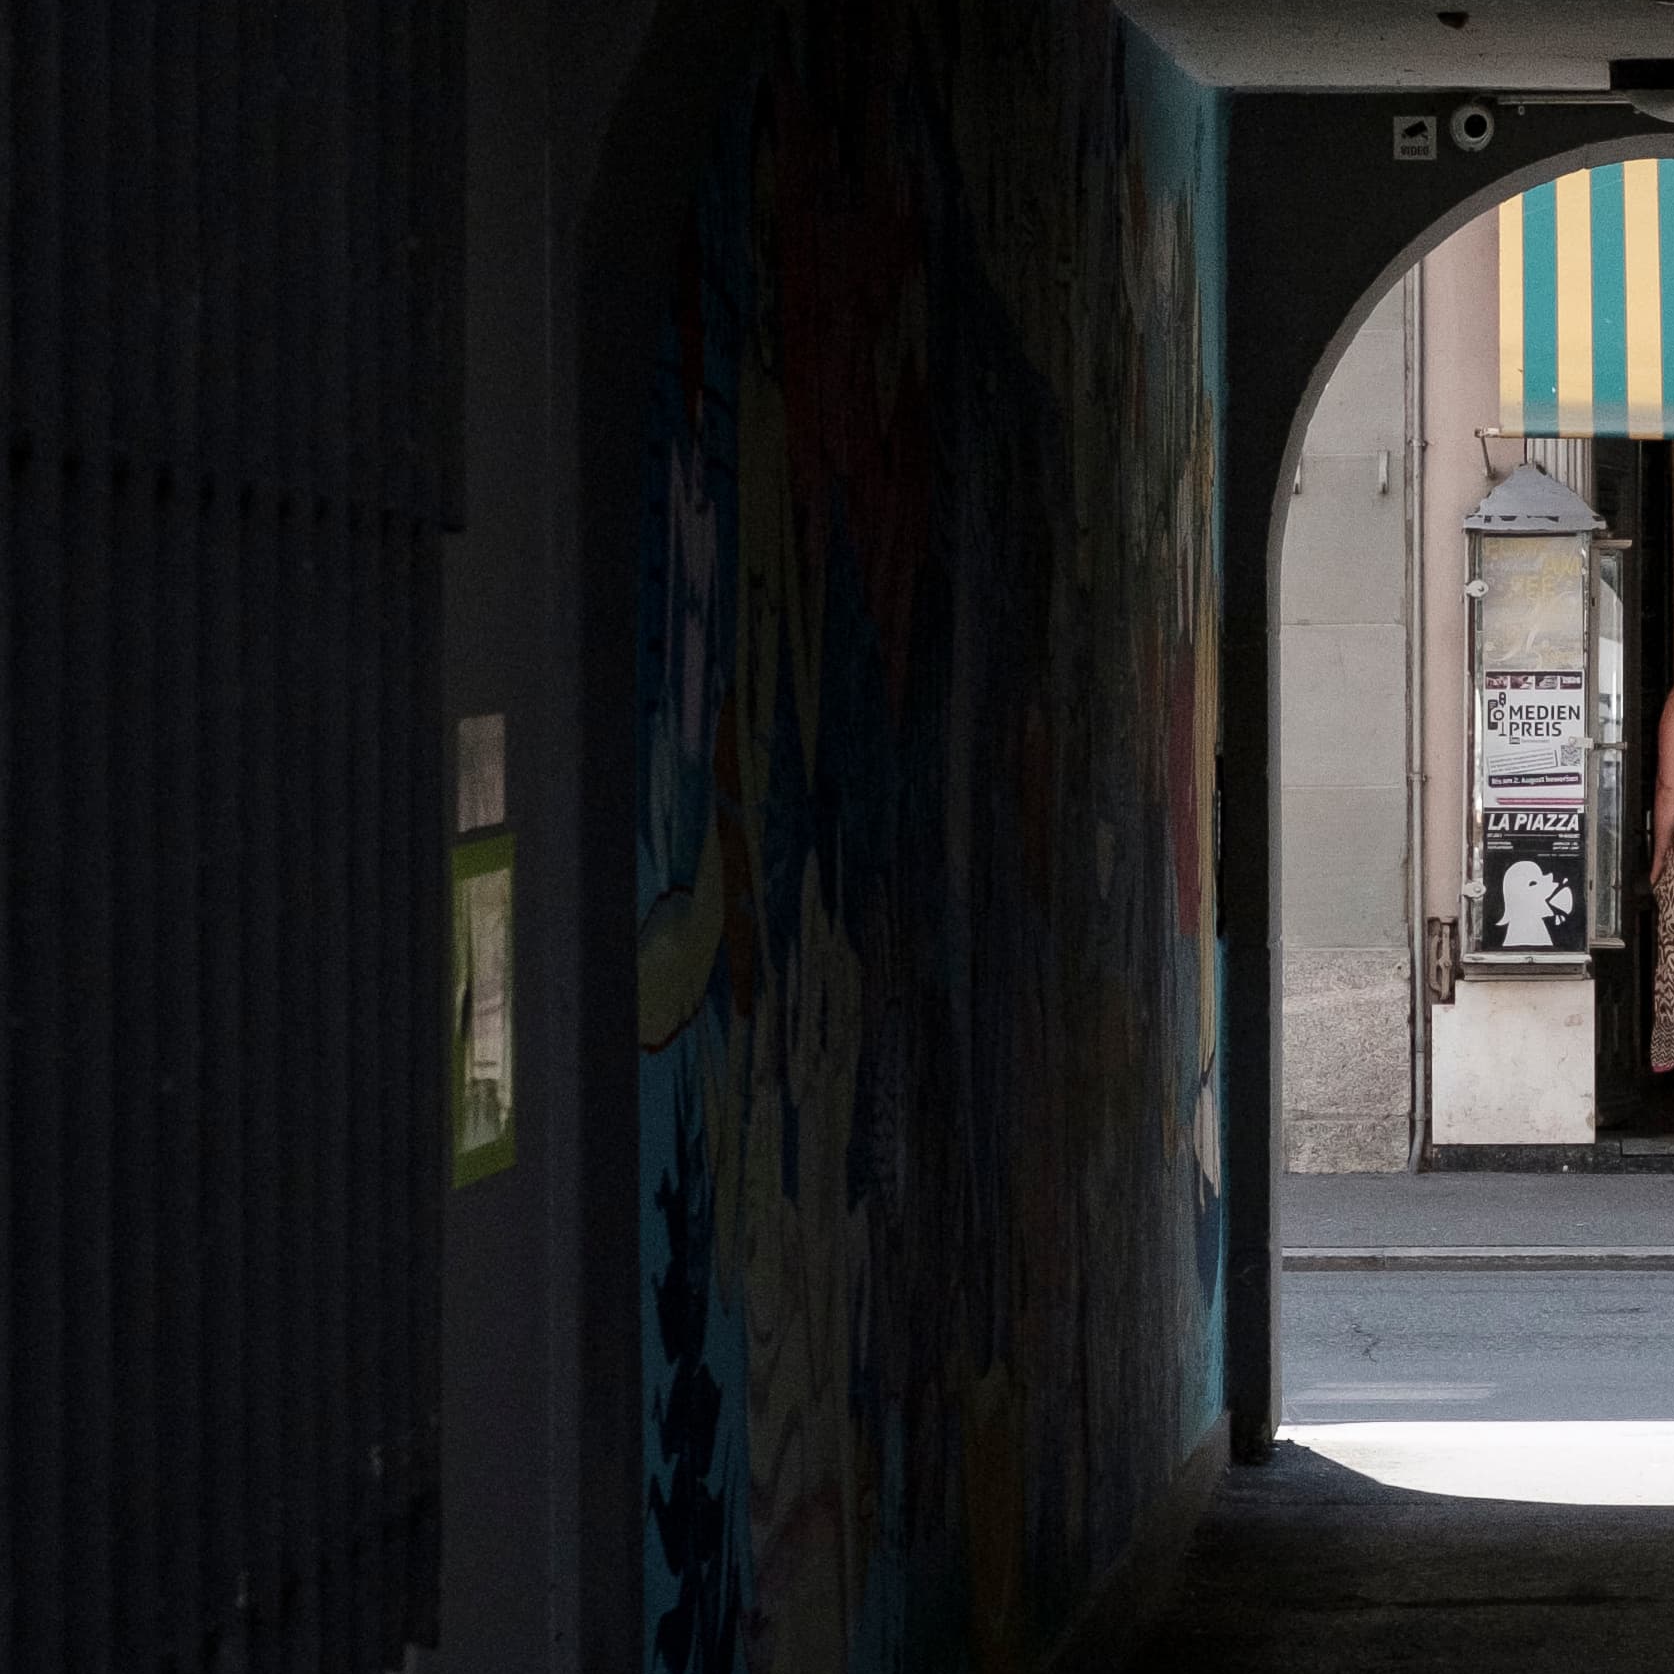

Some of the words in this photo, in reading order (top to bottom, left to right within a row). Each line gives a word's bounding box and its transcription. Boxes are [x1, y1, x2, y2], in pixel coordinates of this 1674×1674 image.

[1509, 705, 1580, 720] MEDIEN
[1509, 722, 1562, 737] PREIS
[1487, 814, 1510, 831] LA
[1513, 814, 1580, 831] PIAZZA
